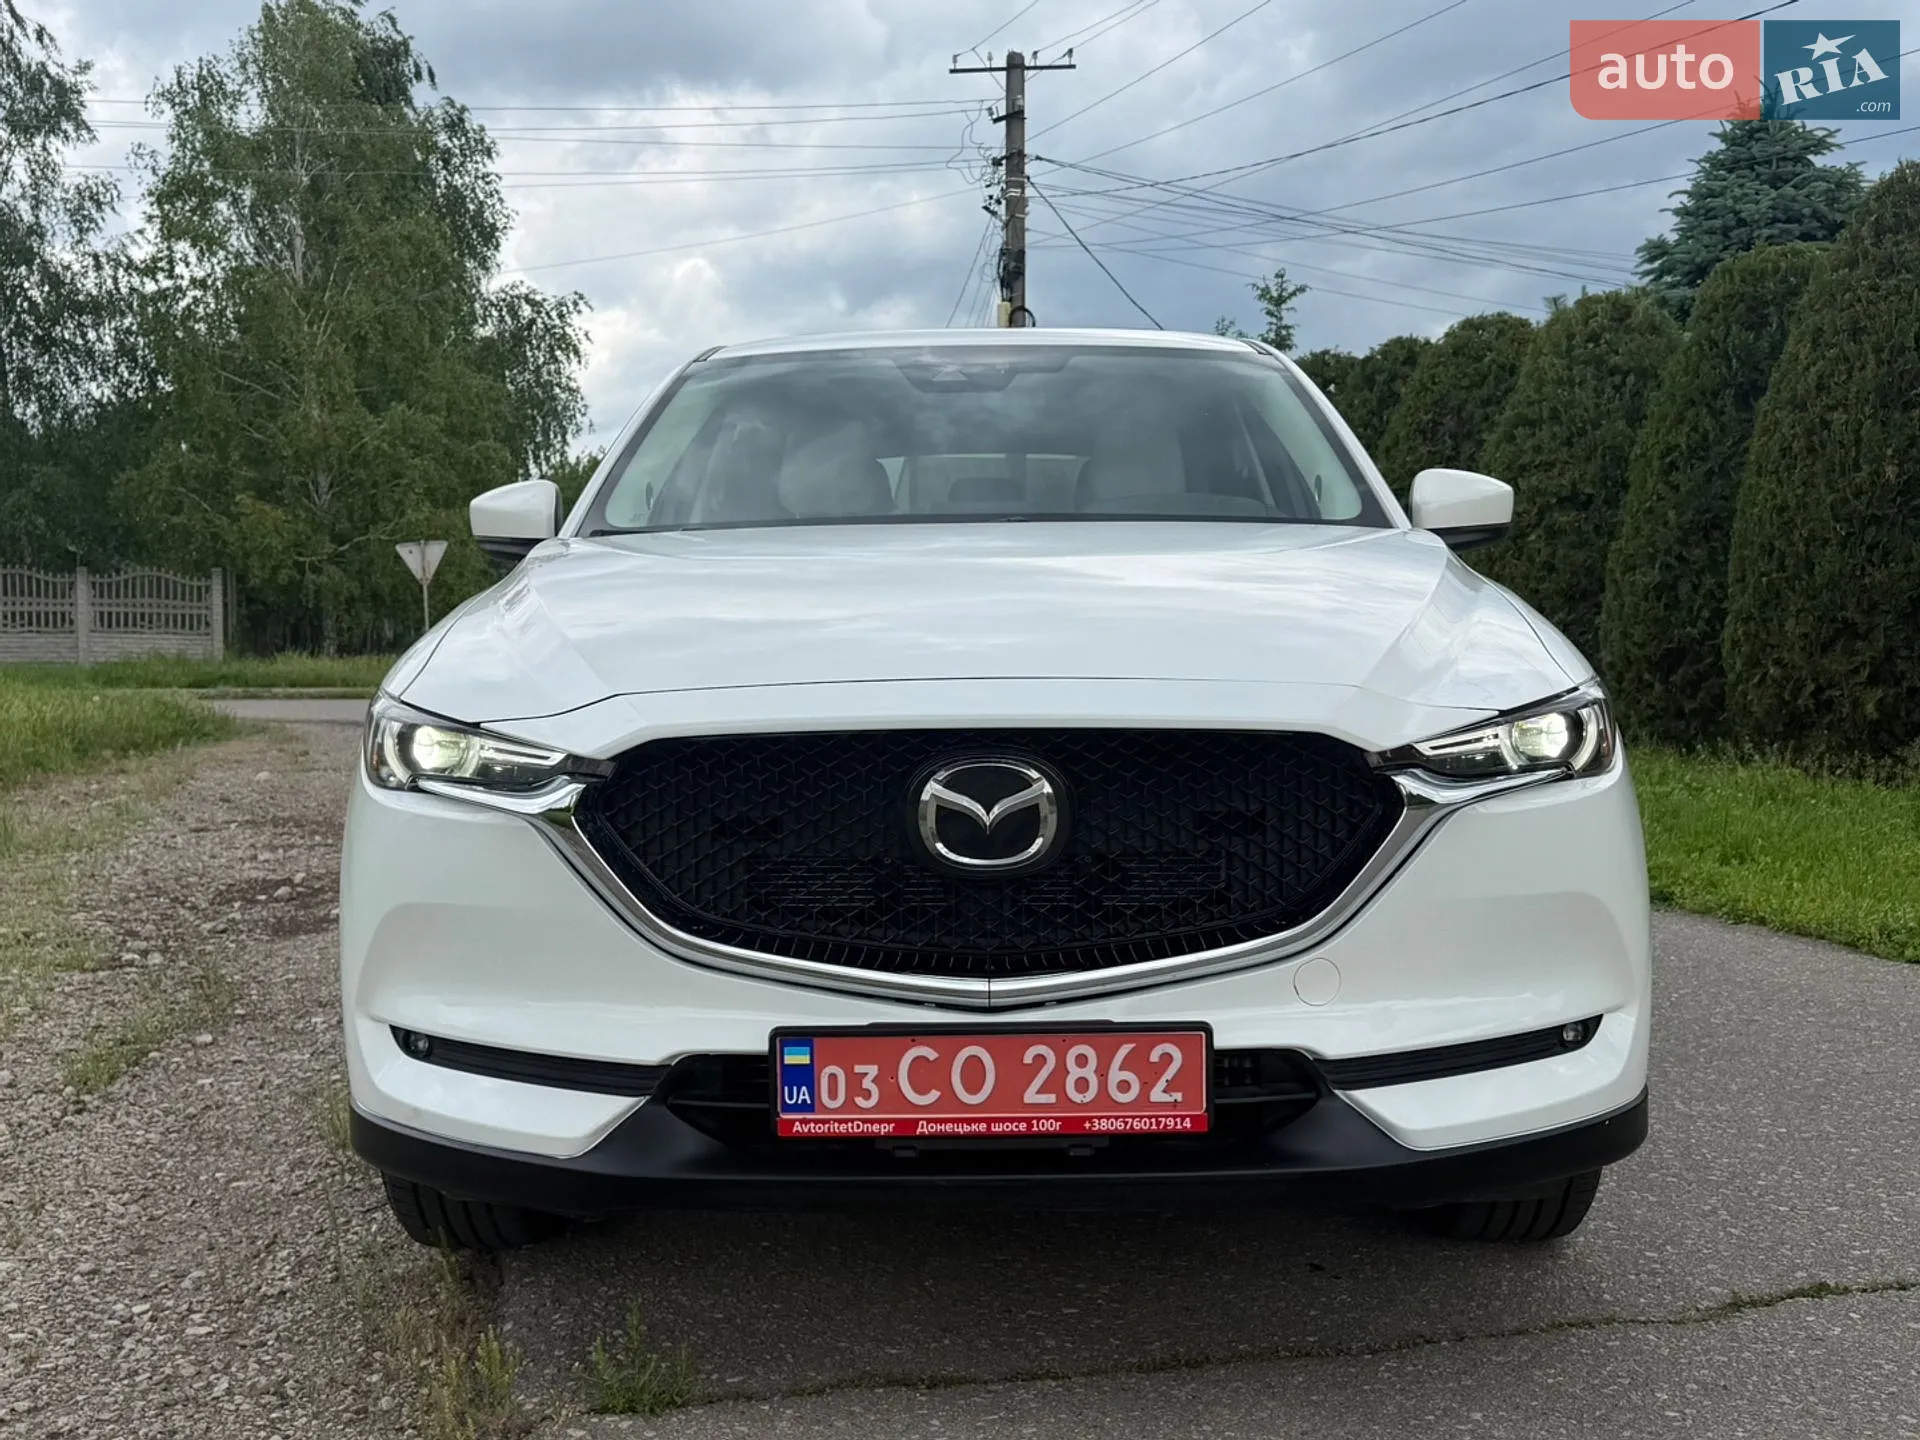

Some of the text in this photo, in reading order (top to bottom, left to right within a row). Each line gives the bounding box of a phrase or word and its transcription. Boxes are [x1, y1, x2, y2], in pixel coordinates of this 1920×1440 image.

[819, 1043, 1183, 1109] 03 CO 2862
[784, 1085, 811, 1104] UA
[792, 1121, 895, 1135] AvtoritetDnepr
[916, 1119, 1062, 1134] Донецьке шосе 100г
[1083, 1117, 1191, 1130] +380676017914
